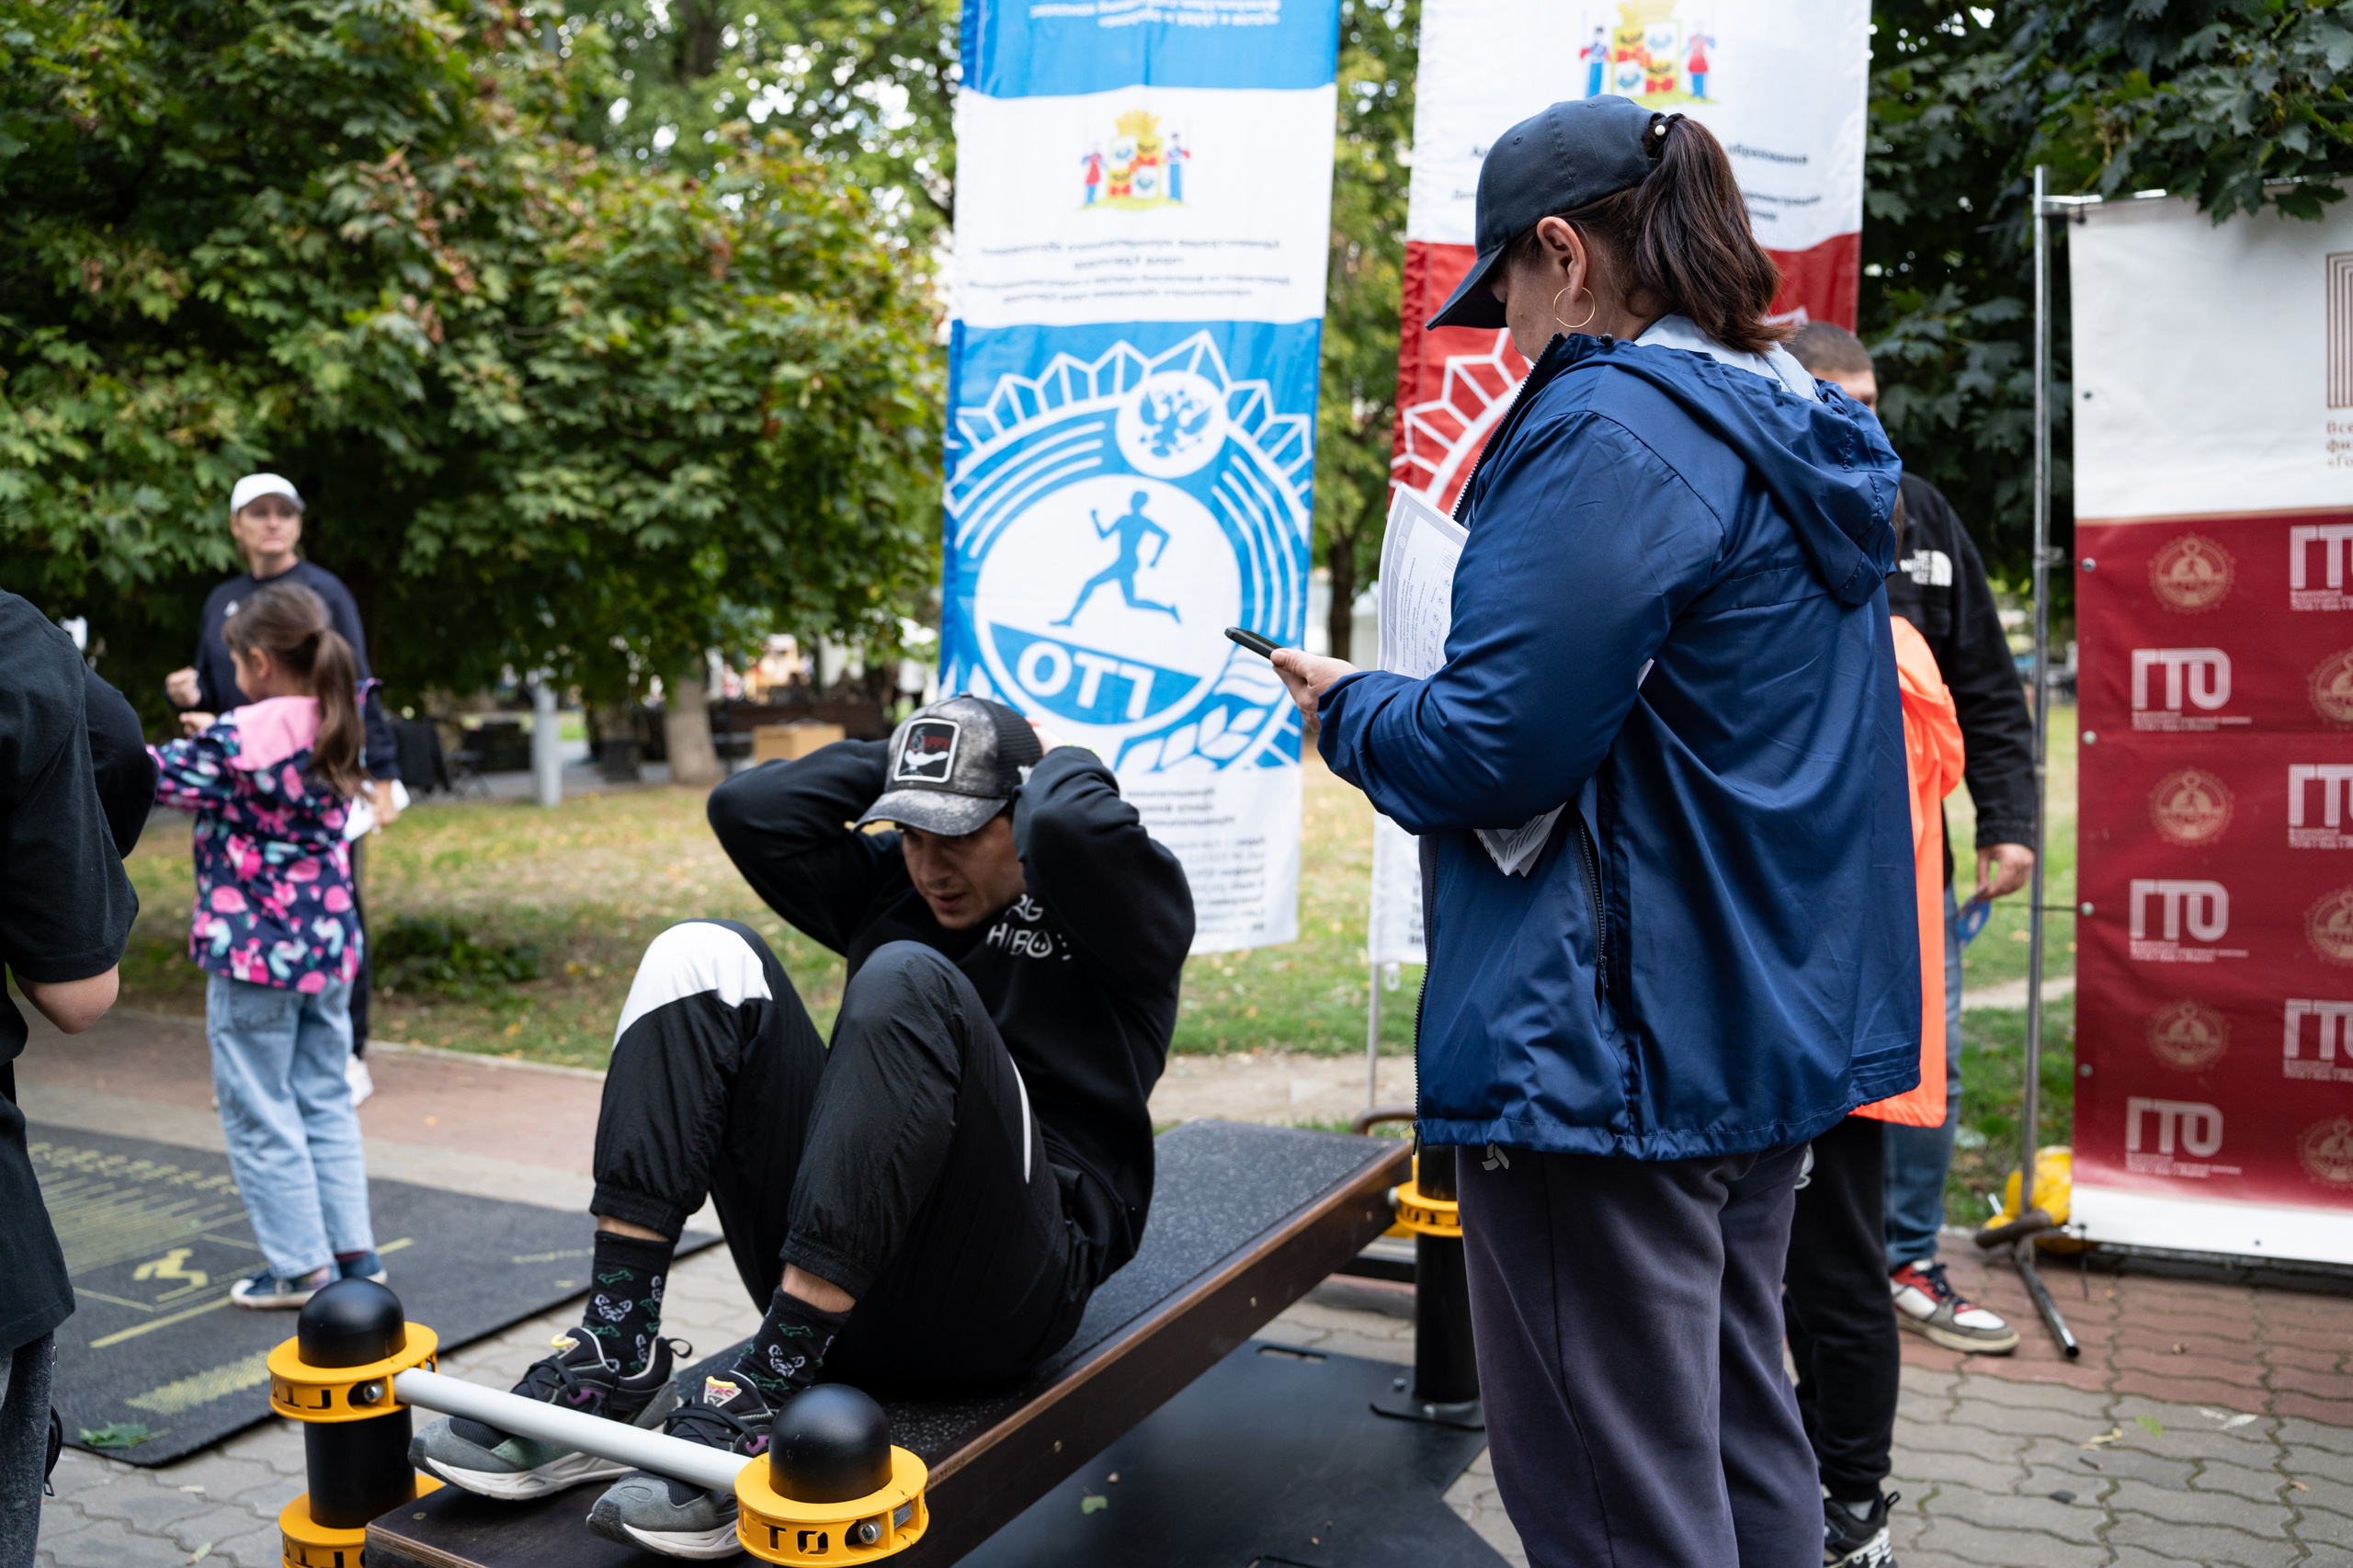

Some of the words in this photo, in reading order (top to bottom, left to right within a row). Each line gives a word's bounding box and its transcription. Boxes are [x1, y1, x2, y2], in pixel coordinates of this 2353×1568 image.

[2289, 523, 2353, 590] ГТ
[2131, 647, 2232, 710] ГТО
[2288, 763, 2353, 828] ГТ
[2130, 879, 2230, 942] ГТО
[2283, 998, 2353, 1061] ГТ
[2125, 1096, 2224, 1158] ГТО
